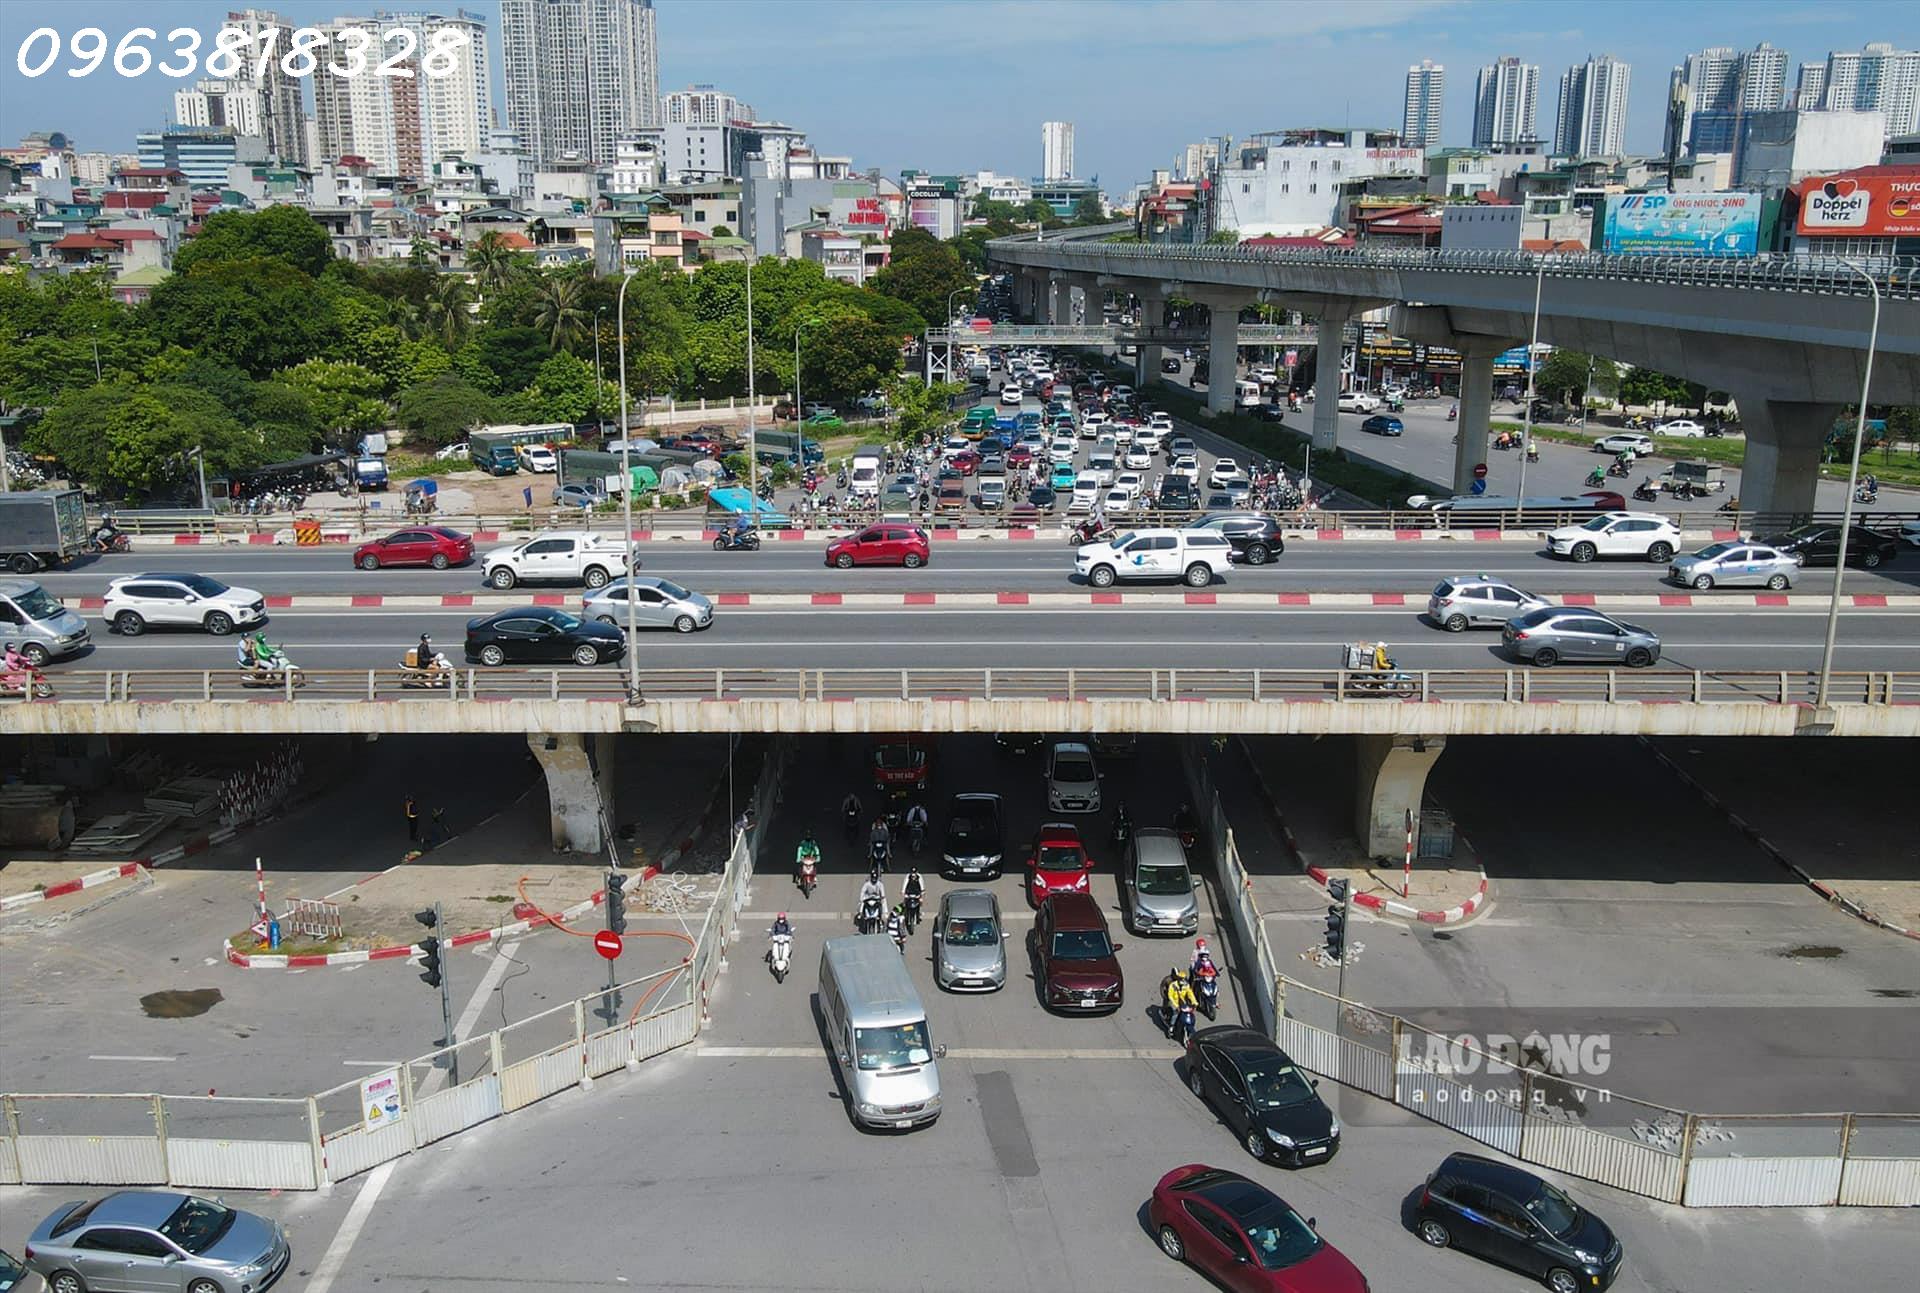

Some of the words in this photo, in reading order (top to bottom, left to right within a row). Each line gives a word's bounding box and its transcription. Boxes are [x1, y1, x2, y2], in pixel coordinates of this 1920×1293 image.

[1721, 198, 1746, 208] SINO
[1813, 198, 1862, 211] Doppel
[1822, 211, 1850, 220] herz
